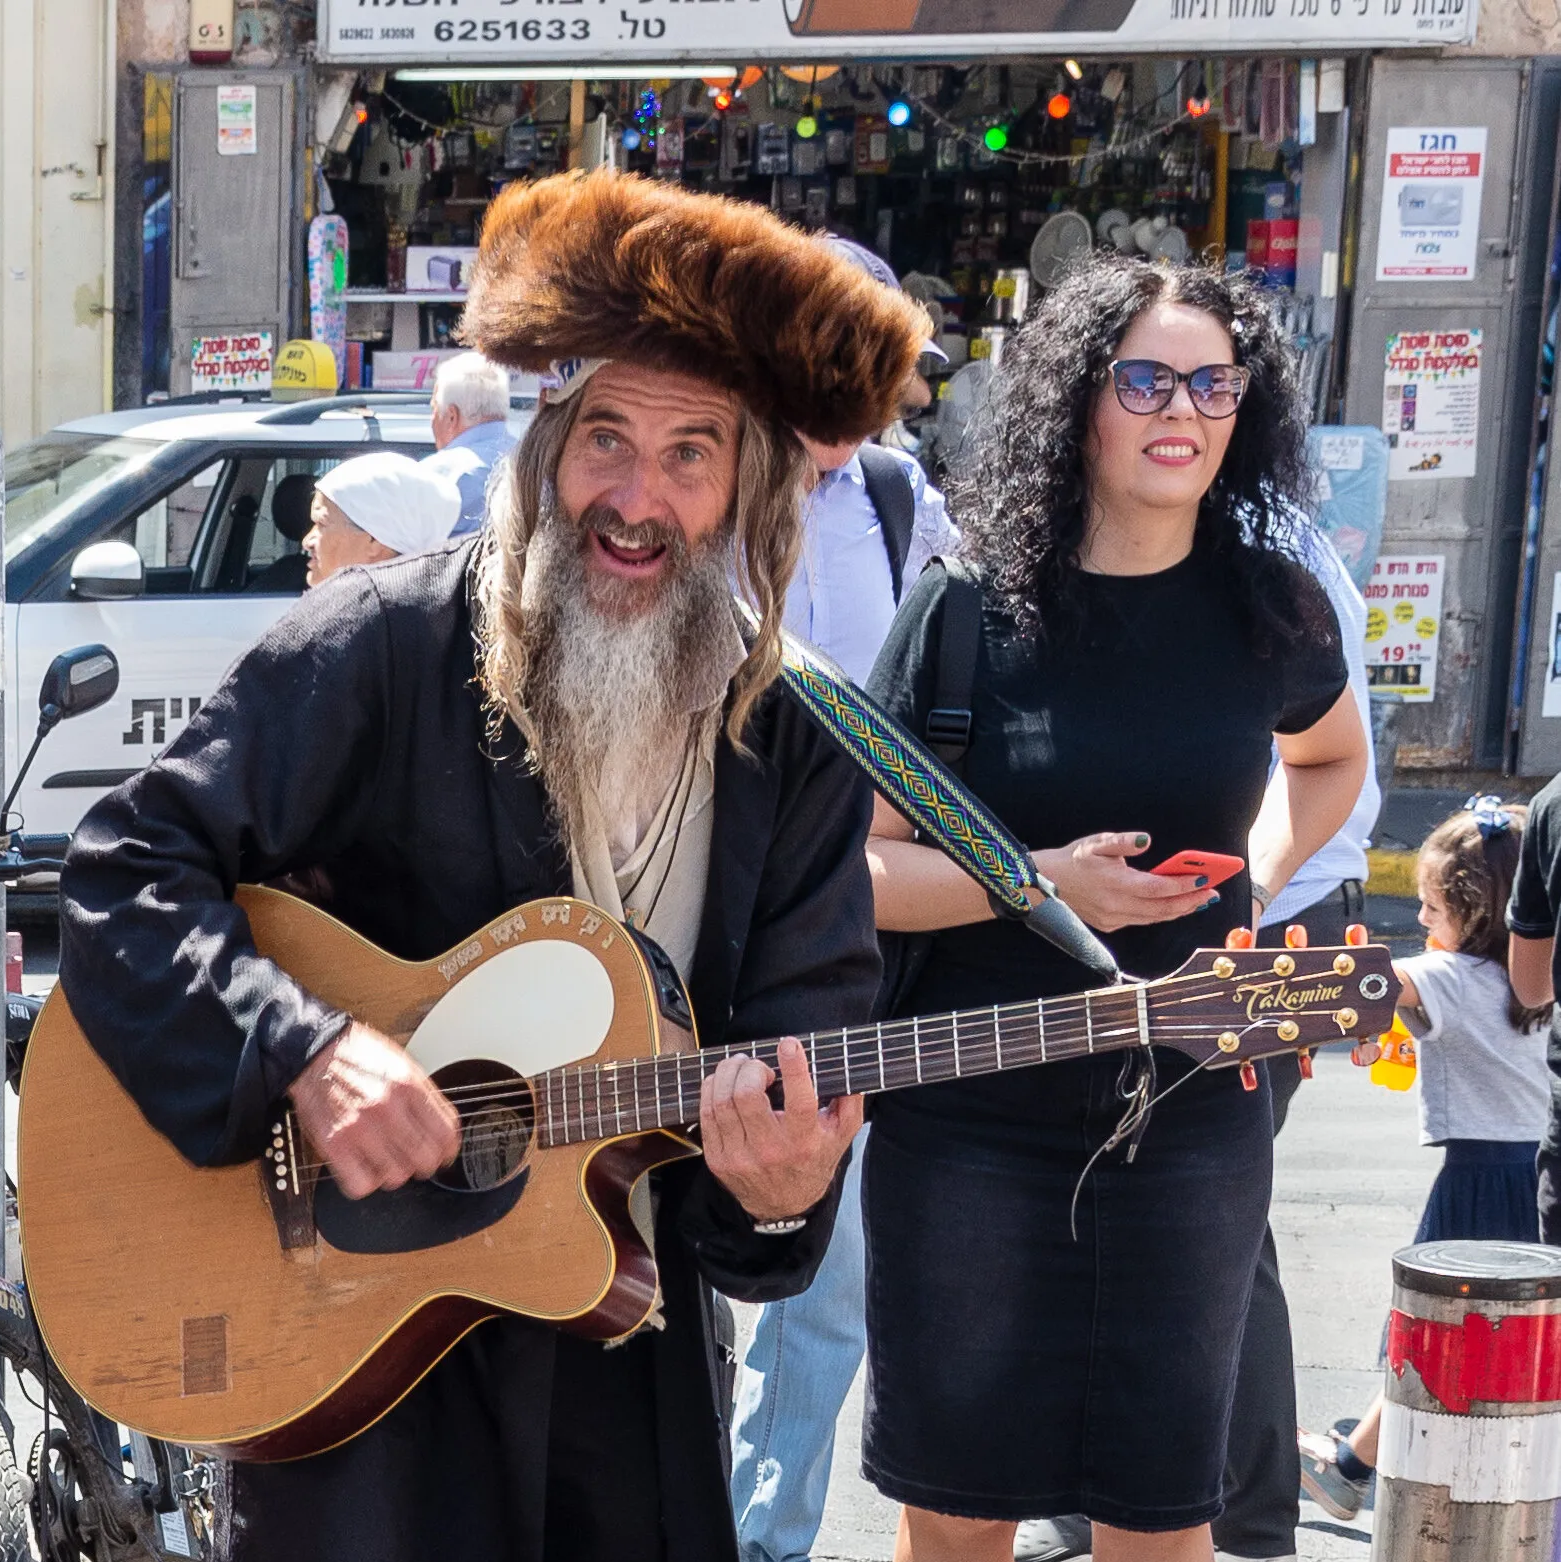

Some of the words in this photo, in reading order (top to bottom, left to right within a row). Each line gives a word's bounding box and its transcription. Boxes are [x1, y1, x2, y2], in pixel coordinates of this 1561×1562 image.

[434, 19, 591, 42] 6251633
[617, 10, 667, 40] טל.
[1233, 984, 1344, 1022] Takamine
